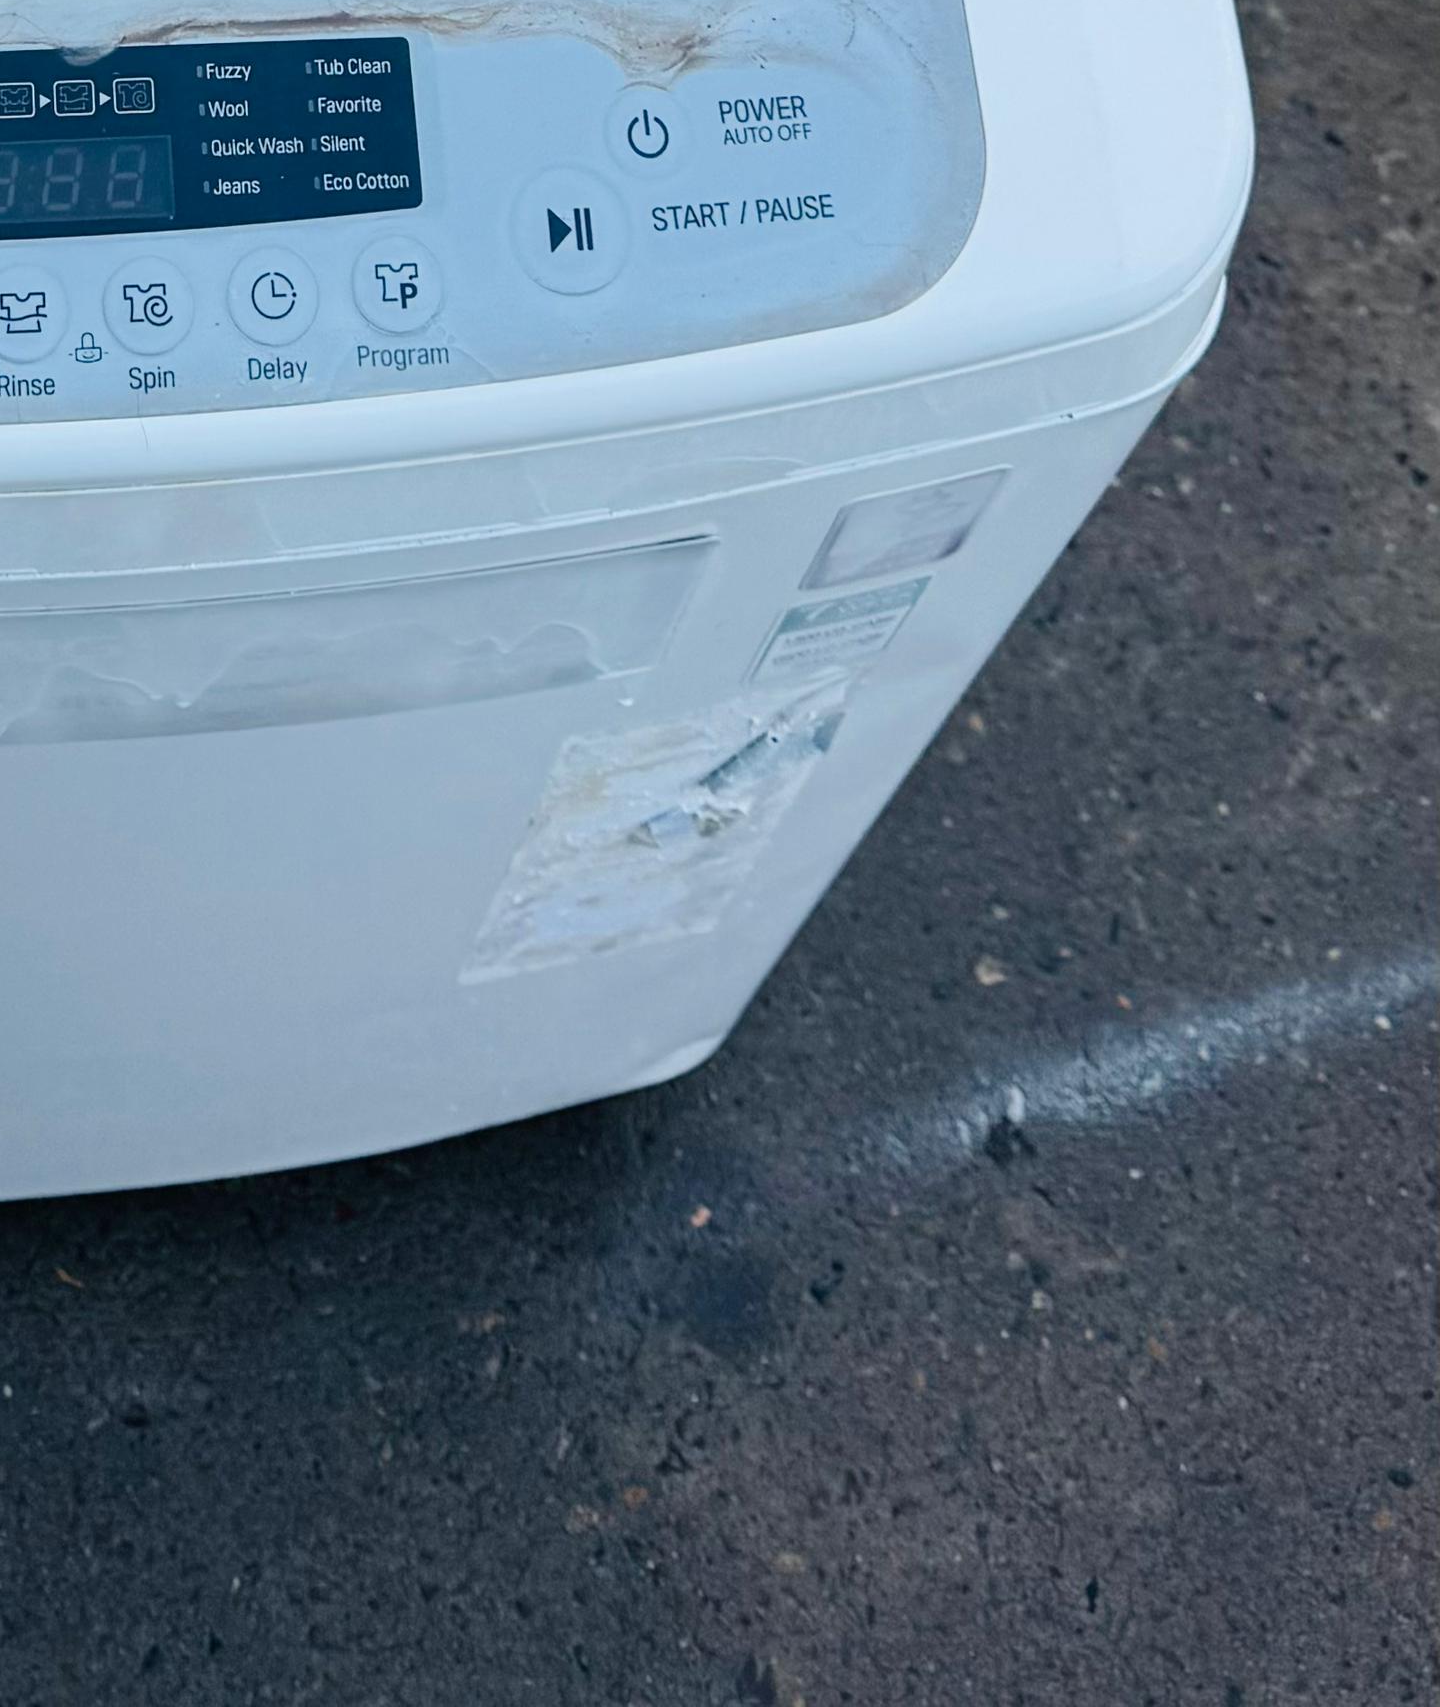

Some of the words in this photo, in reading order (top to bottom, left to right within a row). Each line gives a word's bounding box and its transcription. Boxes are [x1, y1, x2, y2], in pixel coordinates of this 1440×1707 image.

[206, 62, 251, 81] Fuzzy
[314, 59, 344, 76] Tub
[348, 57, 391, 74] Clean
[209, 101, 249, 118] Wool
[318, 96, 382, 114] Favorite
[719, 95, 807, 124] POWER
[723, 126, 773, 145] AUTO
[777, 123, 812, 142] OFF
[211, 138, 255, 157] Quick
[258, 137, 303, 154] Wash
[320, 135, 365, 153] Silent
[213, 178, 260, 195] Jeans
[324, 174, 352, 191] Eco
[356, 172, 409, 189] Cotton
[652, 201, 730, 232] START
[756, 194, 835, 223] PAUSE
[357, 345, 450, 370] Program
[129, 367, 176, 391] Spin
[248, 358, 308, 383] Delay
